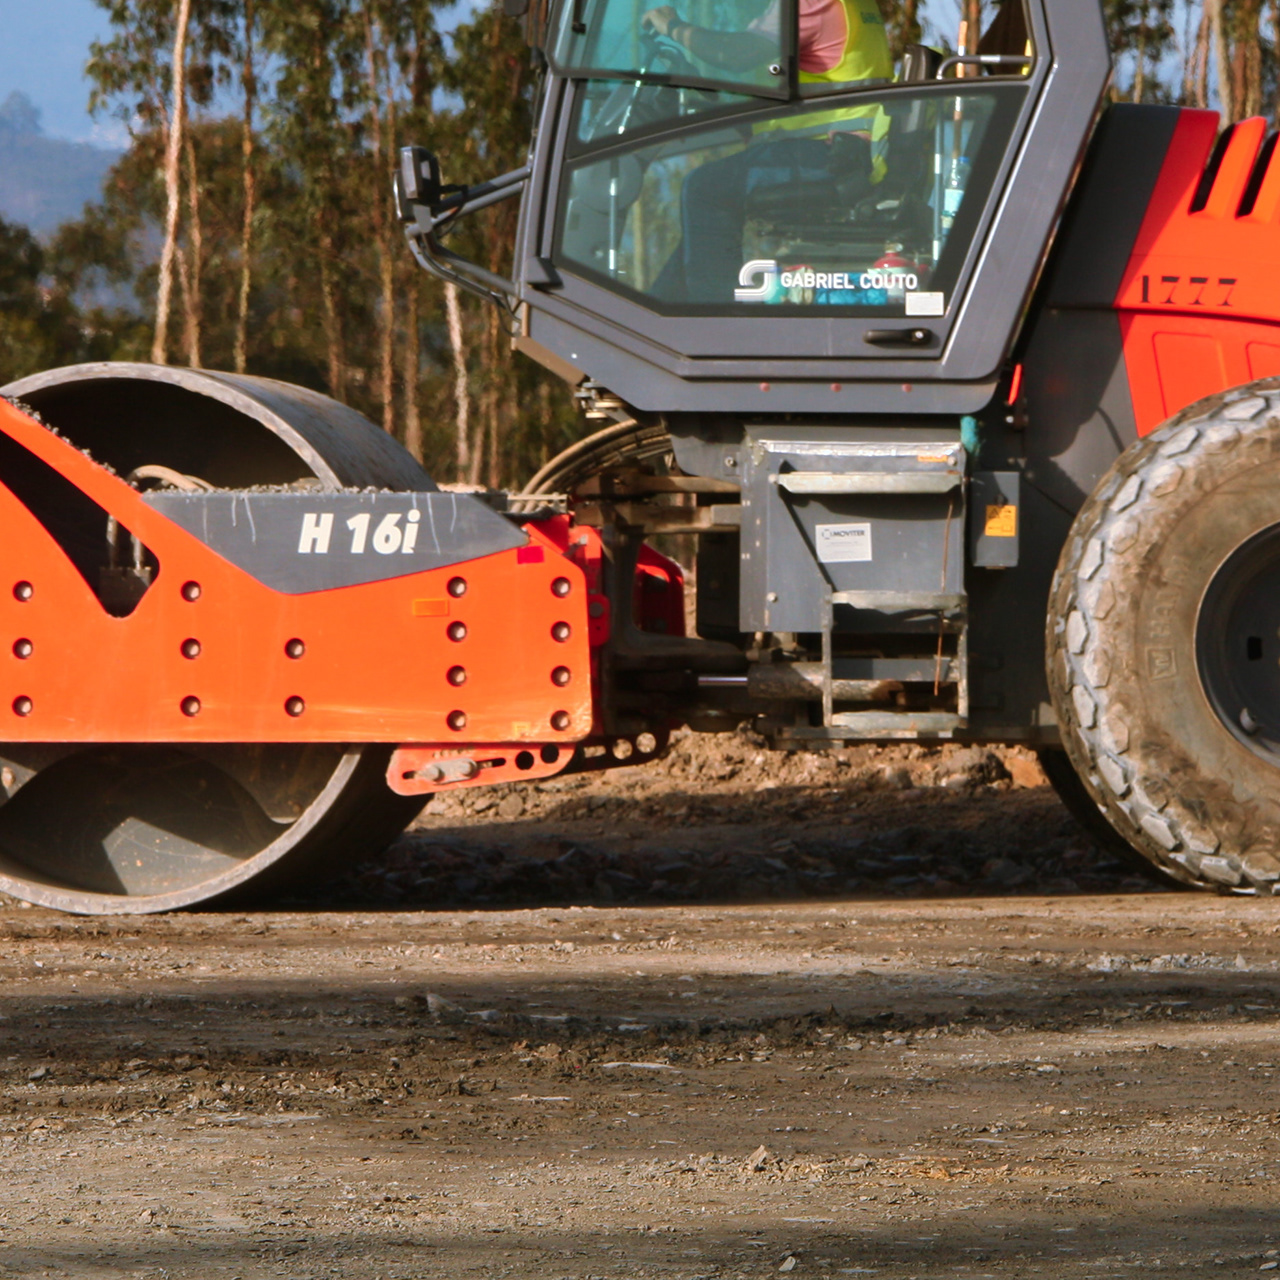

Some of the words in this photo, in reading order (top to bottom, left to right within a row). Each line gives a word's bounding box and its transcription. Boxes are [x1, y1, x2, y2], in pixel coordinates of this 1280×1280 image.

[780, 272, 855, 289] GABRIEL
[859, 273, 918, 289] COUTO
[1139, 275, 1238, 307] 1777
[297, 513, 335, 554] H
[346, 508, 421, 555] 16i
